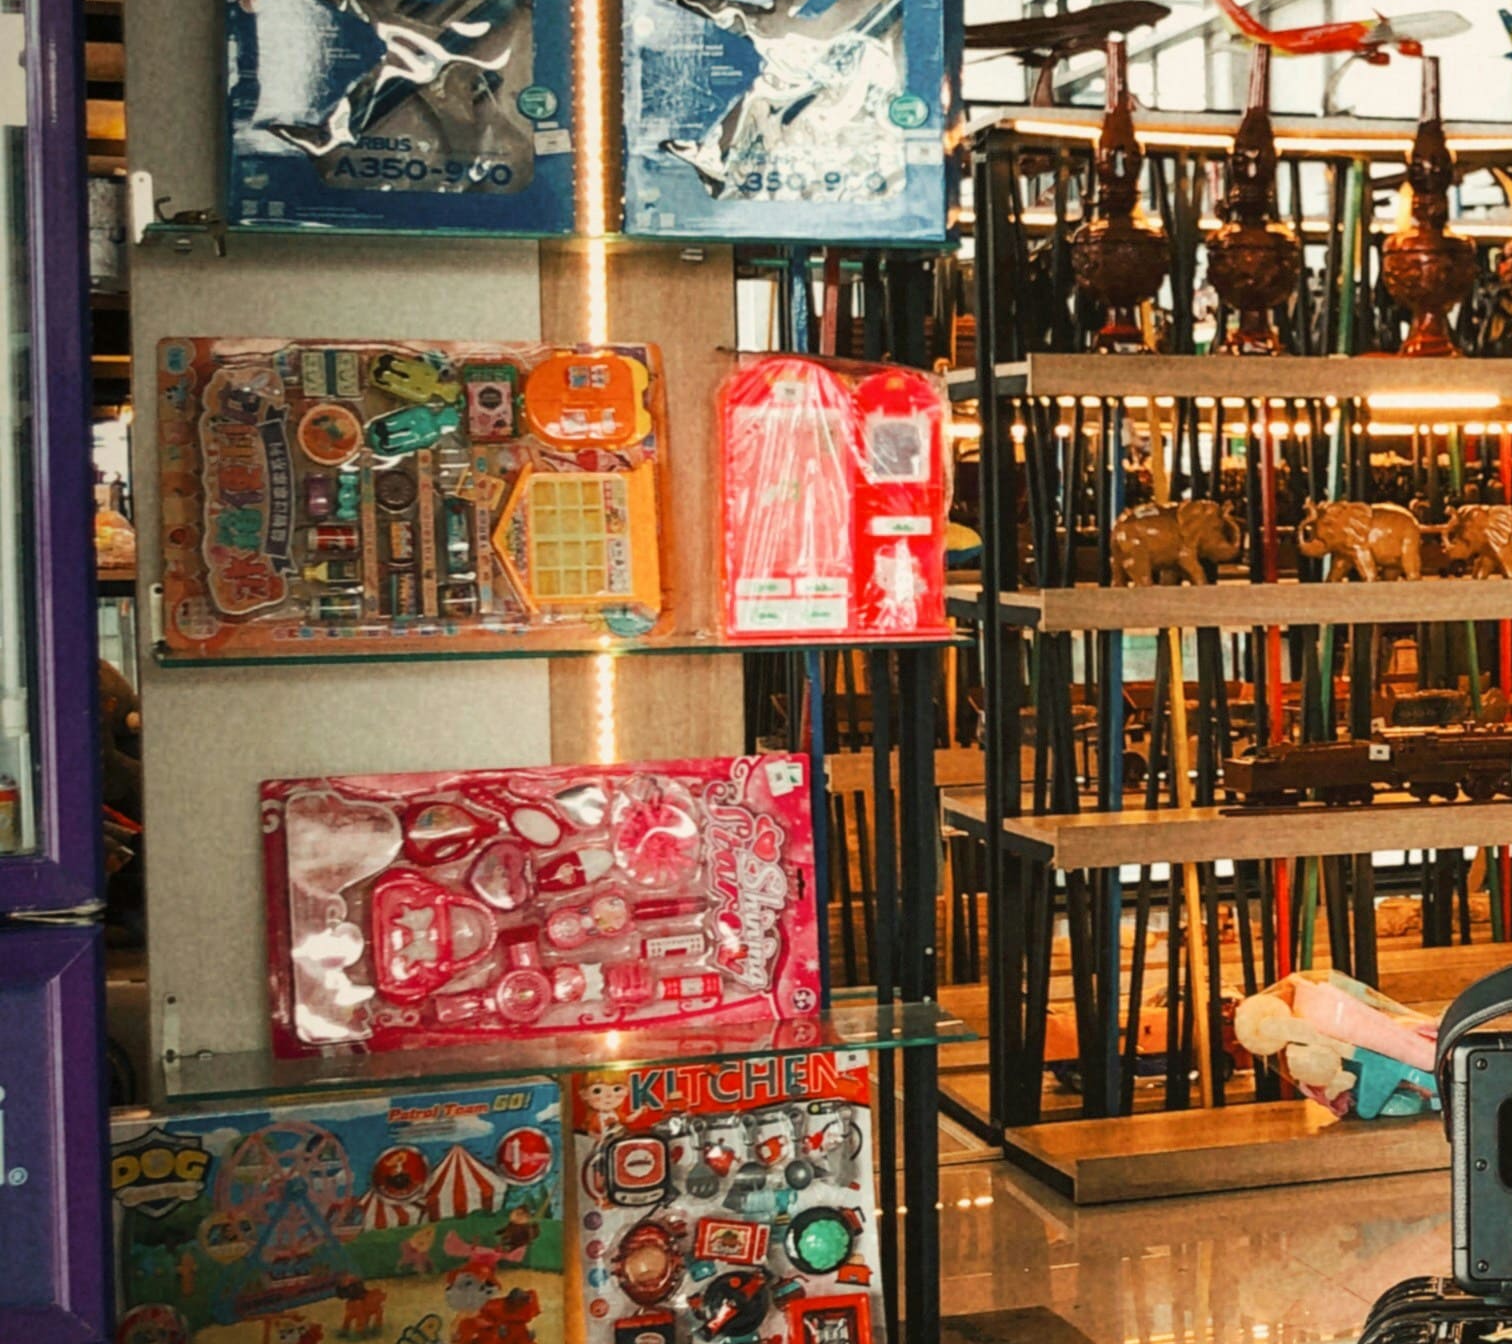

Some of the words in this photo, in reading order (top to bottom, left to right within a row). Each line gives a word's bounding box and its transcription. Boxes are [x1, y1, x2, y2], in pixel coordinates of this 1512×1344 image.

[342, 136, 411, 152] RBUS
[734, 848, 788, 989] Shining
[629, 1052, 839, 1111] KITCHEN
[388, 1105, 439, 1123] Patrol
[443, 1102, 490, 1116] Team
[112, 1148, 208, 1189] DOG
